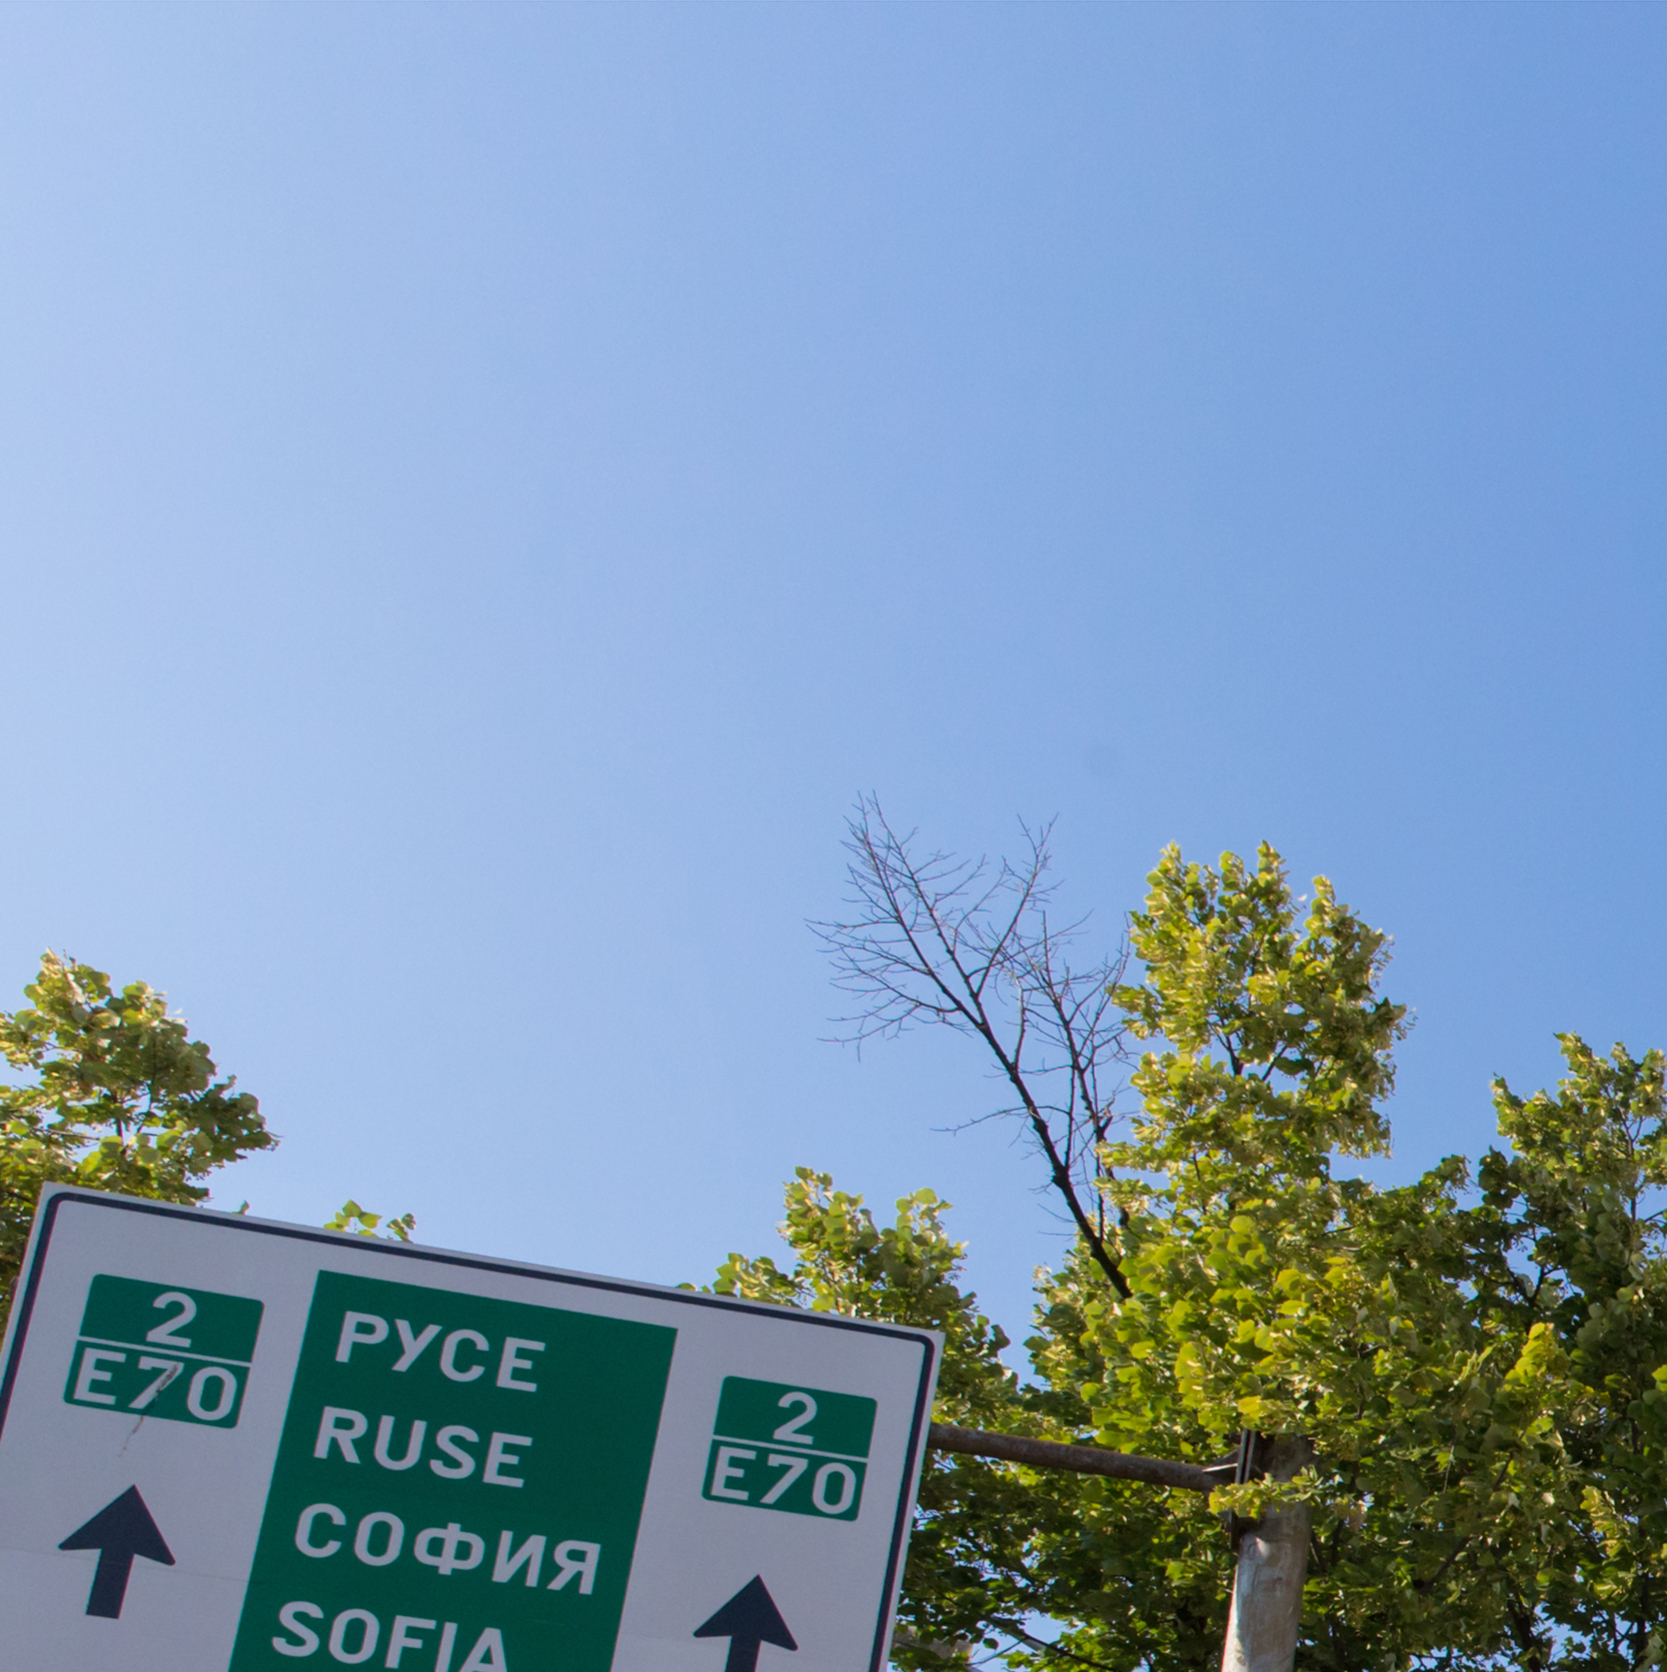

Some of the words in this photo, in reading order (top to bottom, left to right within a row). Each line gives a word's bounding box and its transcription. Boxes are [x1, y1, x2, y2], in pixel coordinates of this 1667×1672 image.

[146, 1292, 198, 1348] 2
[334, 1310, 547, 1393] РУСЕ
[73, 1348, 239, 1422] E70
[772, 1390, 819, 1446] 2
[312, 1405, 534, 1489] RUSE
[710, 1445, 857, 1516] E70
[293, 1502, 602, 1596] СОФИЯ
